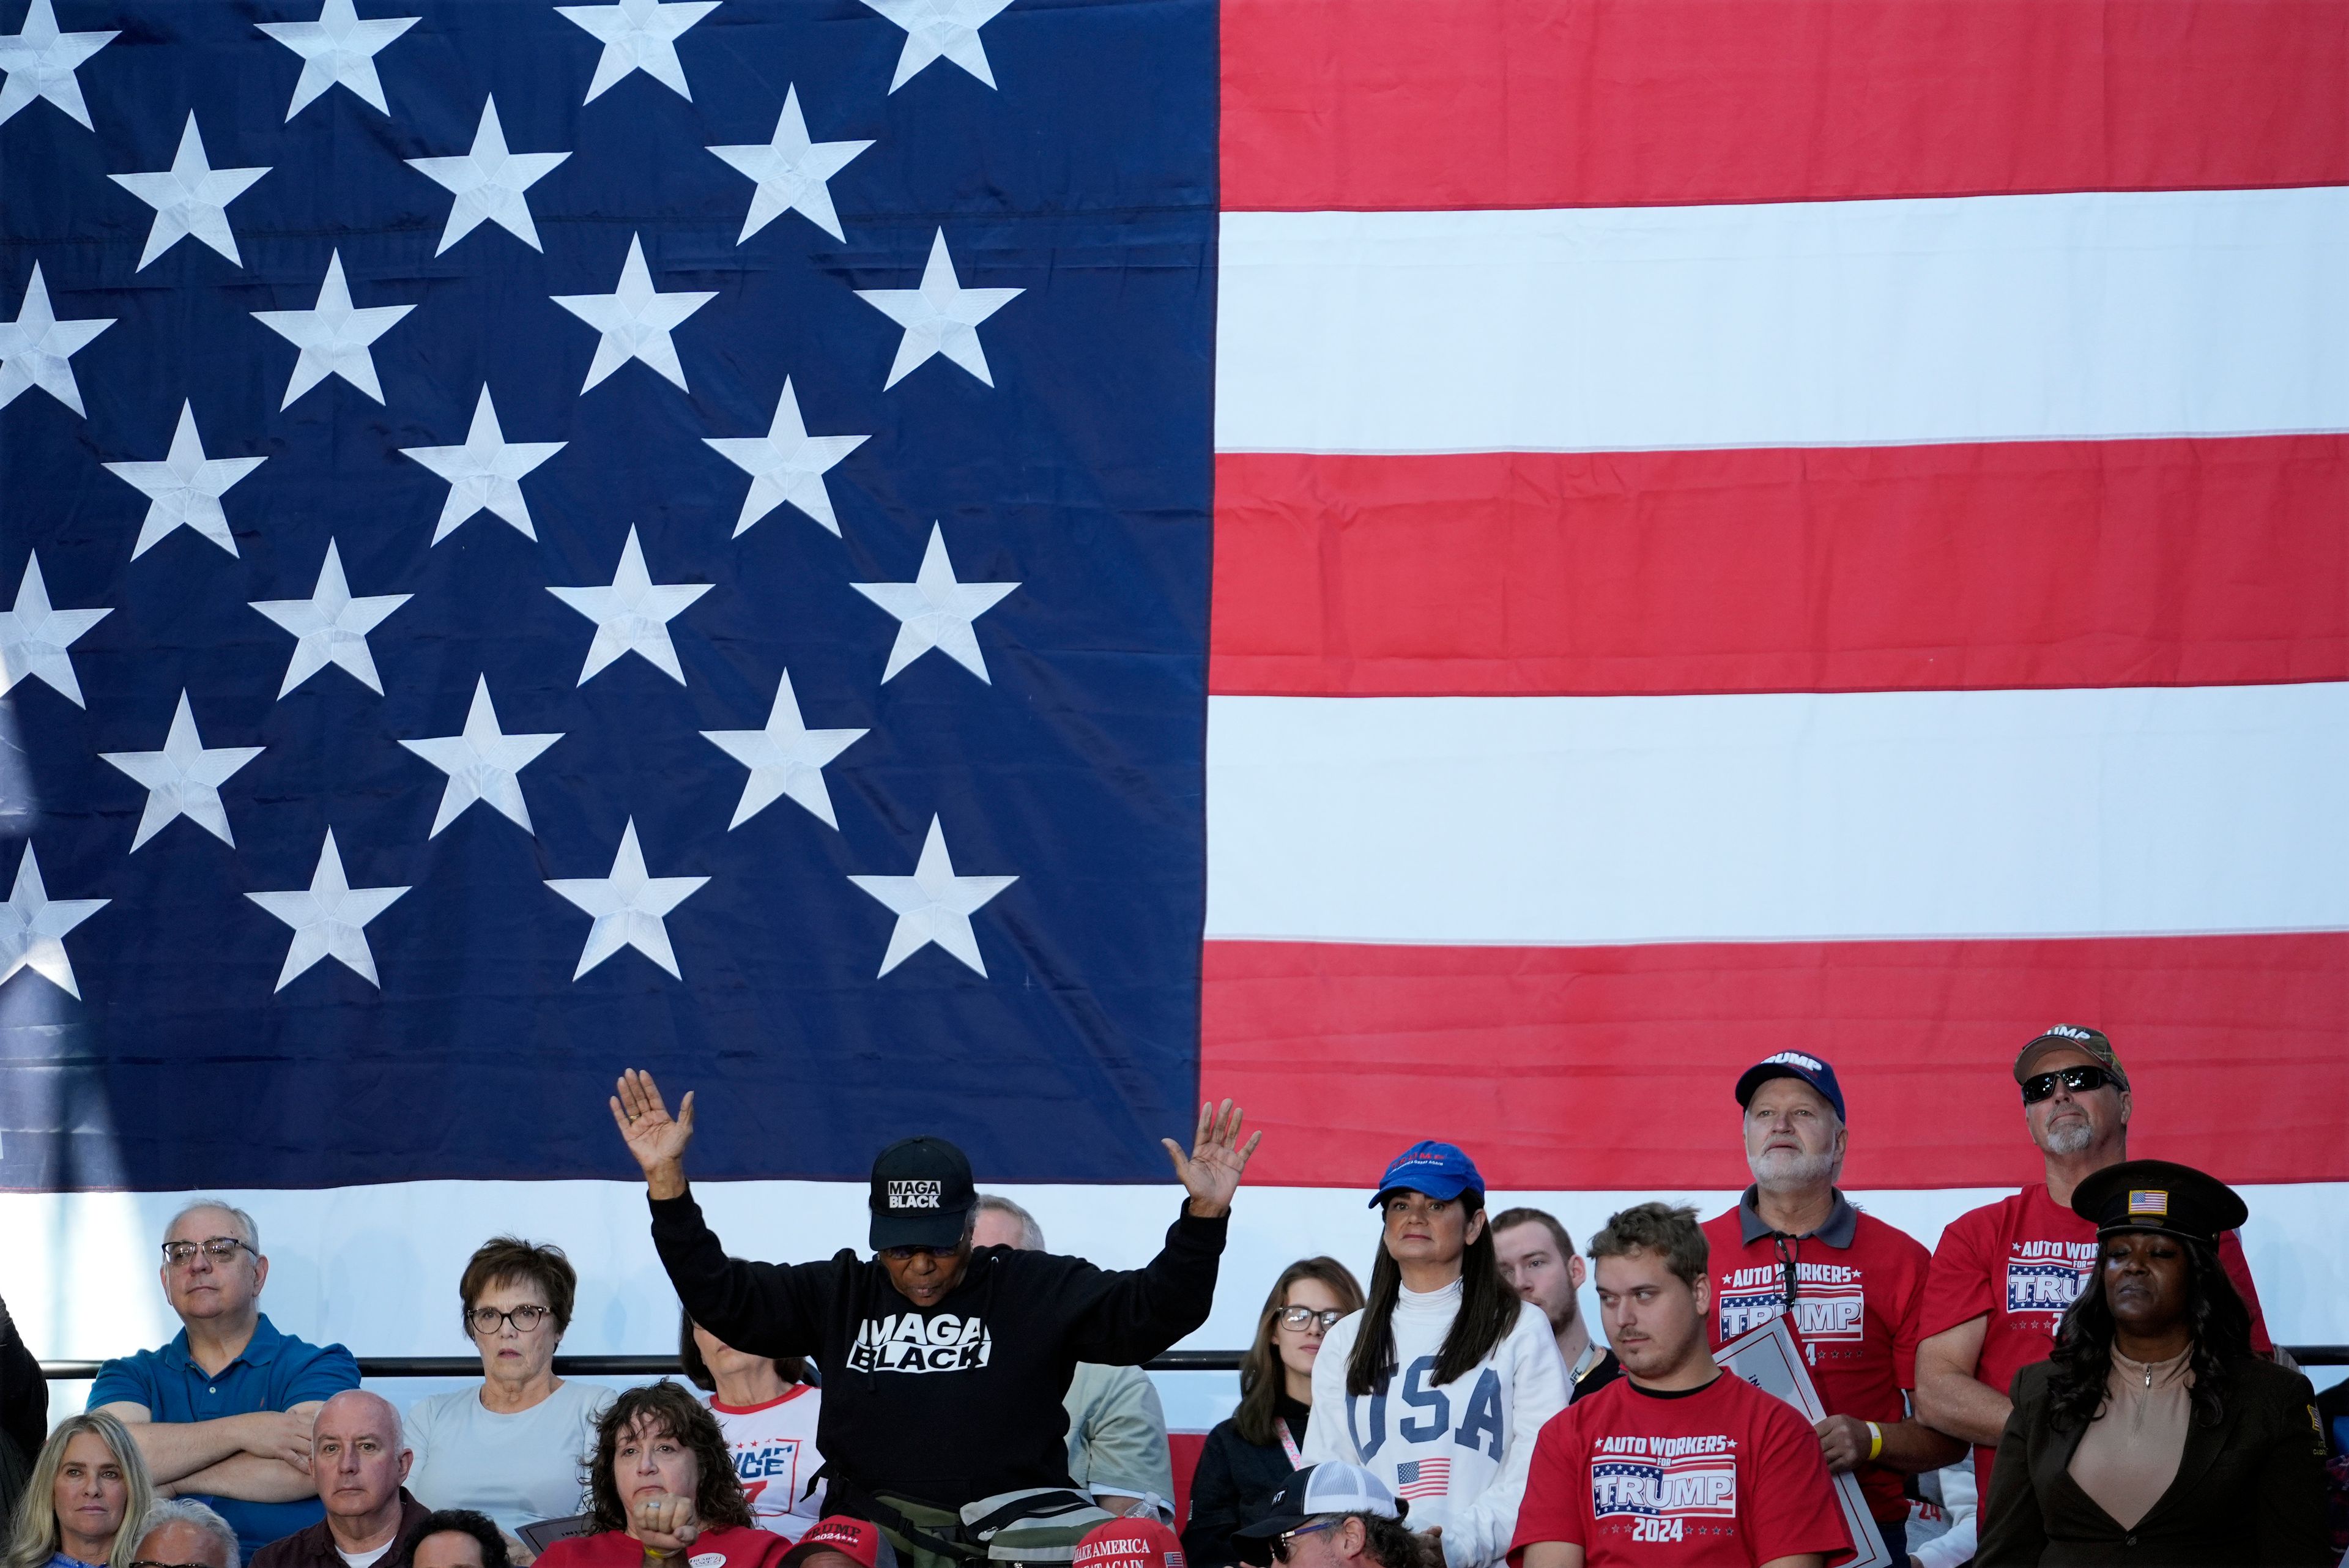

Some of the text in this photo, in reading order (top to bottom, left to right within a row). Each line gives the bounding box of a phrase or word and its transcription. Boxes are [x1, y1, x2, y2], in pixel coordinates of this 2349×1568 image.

[889, 1181, 940, 1194] MAGA
[889, 1195, 940, 1208] BLACK
[2021, 1241, 2063, 1257] AUTO
[1732, 1265, 1772, 1288] AUTO
[858, 1312, 992, 1346] MAGA
[850, 1343, 985, 1370] BLACK
[1345, 1354, 1505, 1466] USA
[1602, 1435, 1727, 1457] AUTO WORKERS
[1657, 1457, 1671, 1467] FOR
[1595, 1475, 1732, 1508] TRUMP
[804, 1523, 861, 1540] TRUMP
[1632, 1517, 1683, 1542] 2024
[1073, 1538, 1151, 1565] MAKE AMERICA
